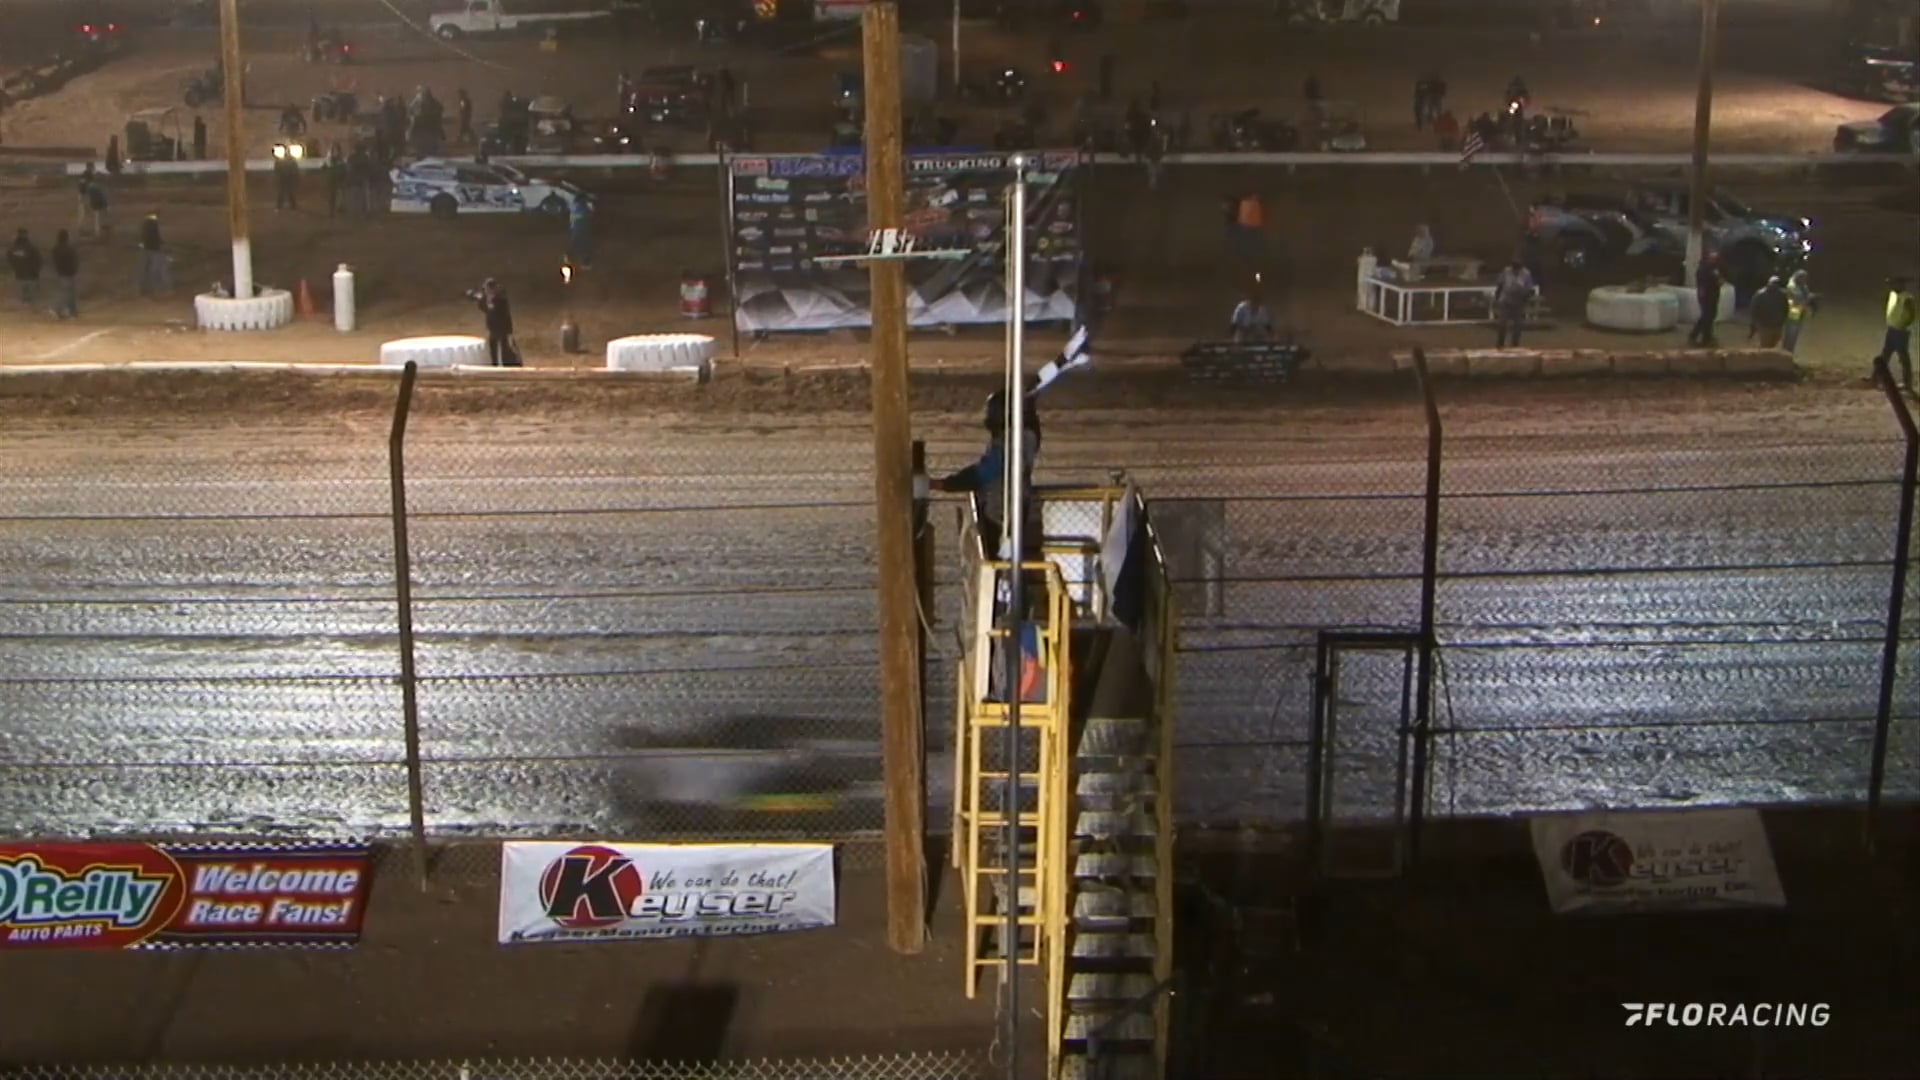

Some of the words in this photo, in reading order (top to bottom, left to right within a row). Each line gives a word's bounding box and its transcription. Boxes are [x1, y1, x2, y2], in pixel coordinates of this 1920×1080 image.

[911, 158, 1001, 171] TRUCKING
[193, 864, 358, 894] Welcome
[546, 854, 797, 922] Keyser
[650, 871, 678, 890] We
[685, 877, 713, 888] can
[720, 870, 739, 887] do
[748, 869, 797, 889] that!
[188, 900, 259, 924] Race
[269, 899, 354, 924] Fans!
[9, 927, 50, 940] AUTO
[53, 923, 103, 938] PARTS
